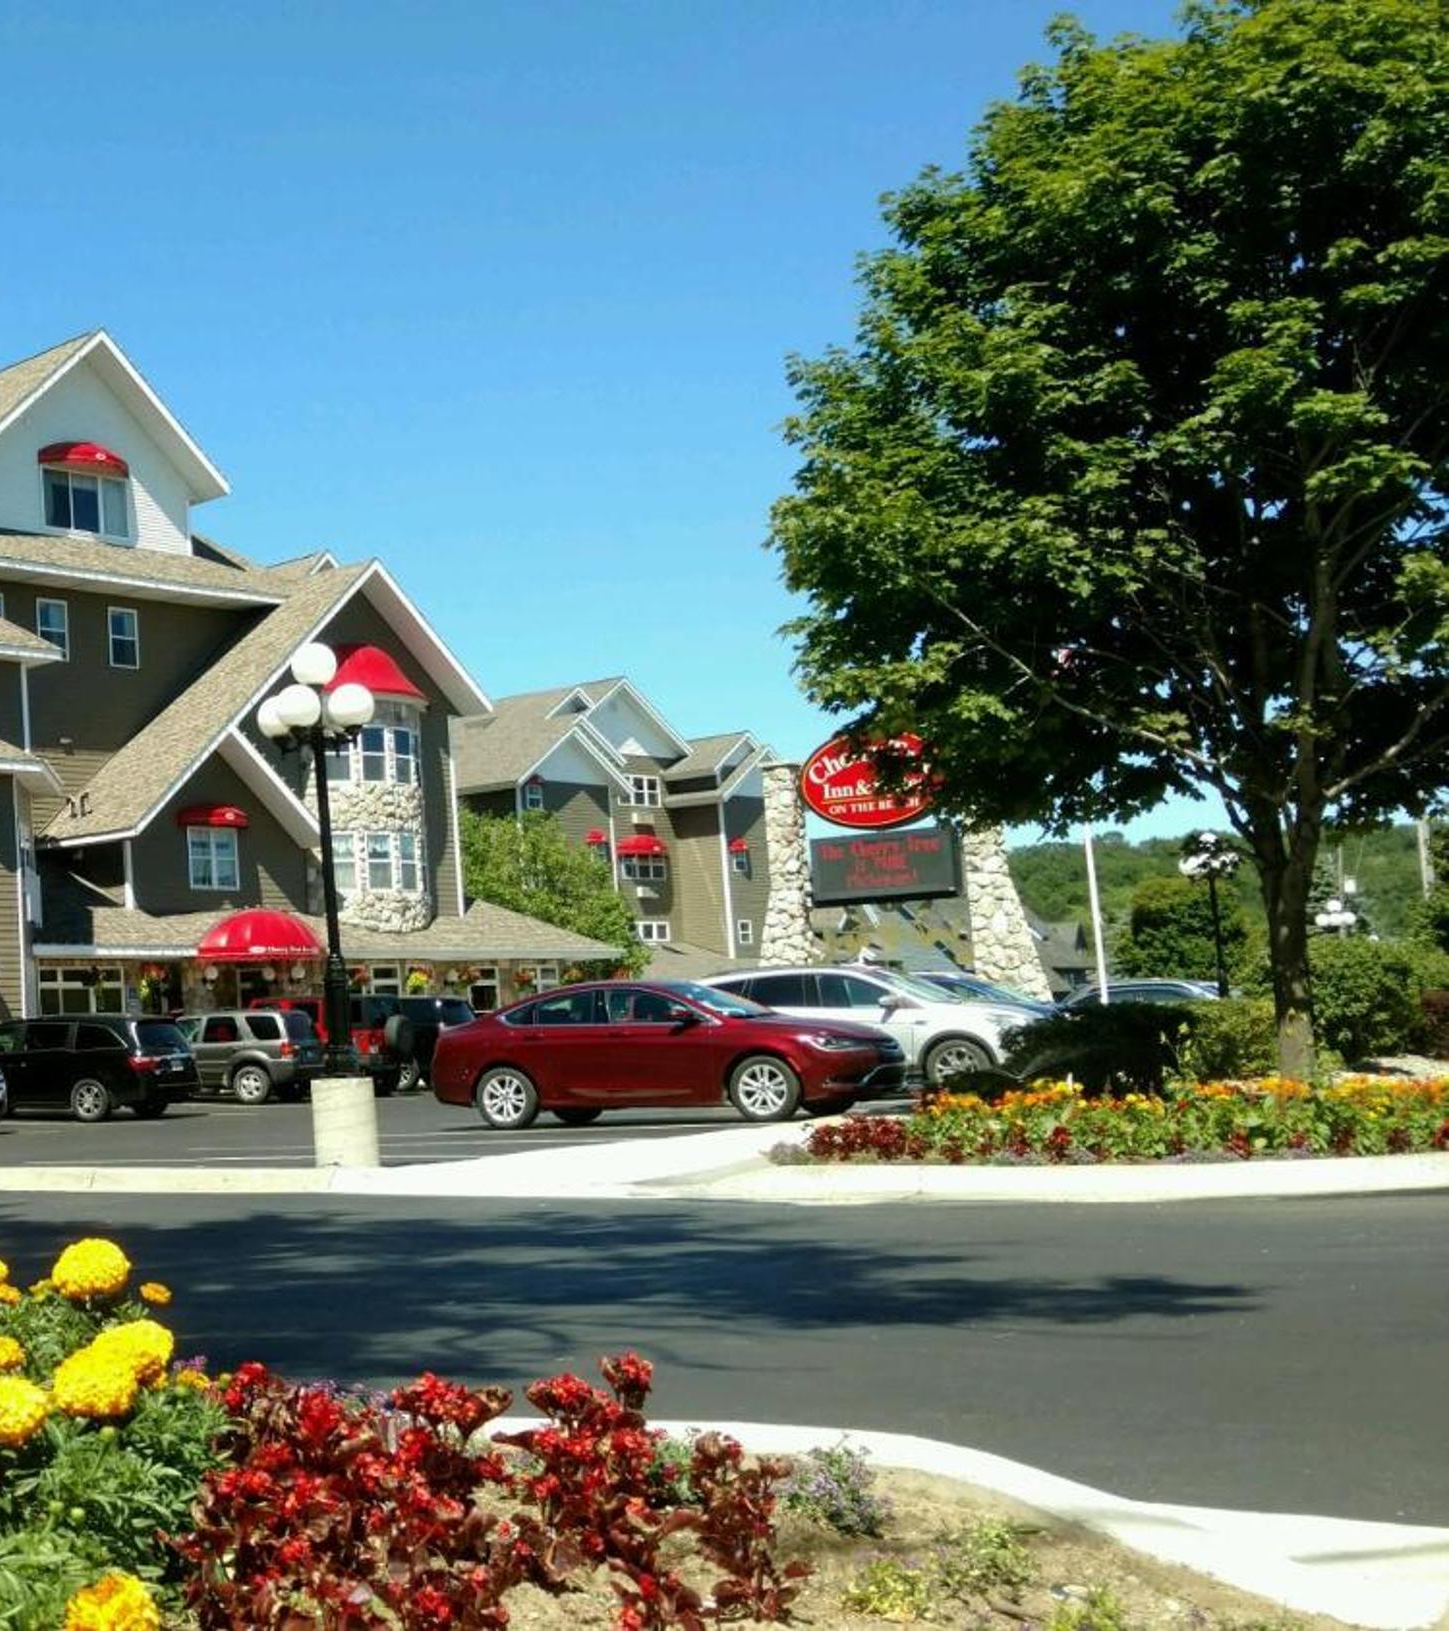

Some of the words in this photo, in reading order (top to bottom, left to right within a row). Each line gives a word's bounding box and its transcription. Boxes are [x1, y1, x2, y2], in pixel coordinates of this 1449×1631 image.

[823, 783, 853, 799] Inn
[855, 779, 871, 796] &
[829, 803, 847, 815] ON
[850, 801, 875, 813] THE
[878, 797, 920, 810] BEH
